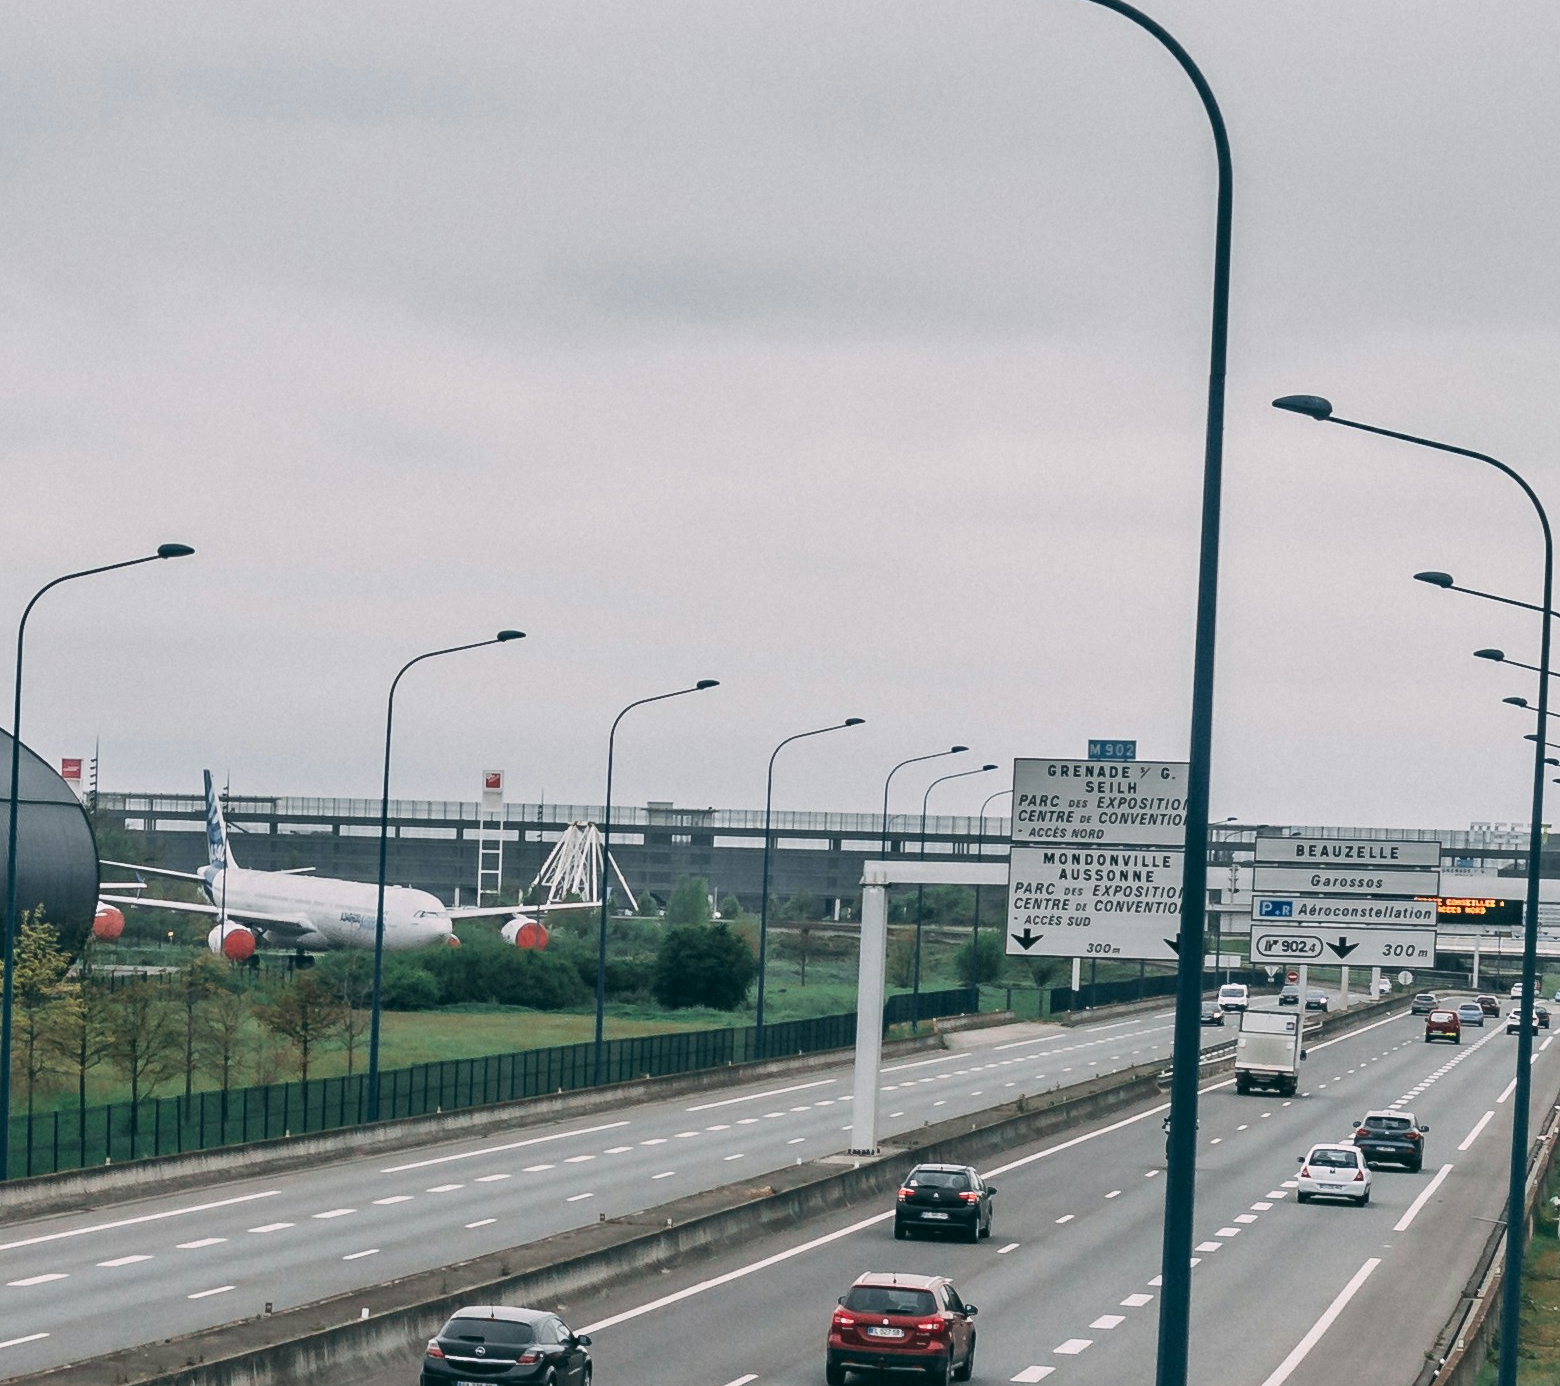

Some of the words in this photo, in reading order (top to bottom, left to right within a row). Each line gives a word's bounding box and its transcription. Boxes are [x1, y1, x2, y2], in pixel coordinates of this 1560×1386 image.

[1090, 744, 1100, 755] M
[1105, 743, 1134, 757] 902
[1048, 764, 1130, 779] GRENADE
[1160, 767, 1176, 780] G.
[1085, 781, 1137, 794] SEILH
[1018, 795, 1060, 807] PARC
[1068, 799, 1088, 809] DES
[1096, 796, 1188, 811] EXPOSITIO
[1018, 810, 1074, 824] CENTRE
[1080, 815, 1092, 824] DE
[1098, 811, 1187, 827] CONVENTIO
[1028, 826, 1067, 838] ACCÈS
[1070, 829, 1105, 839] NORD
[1296, 844, 1399, 859] BEAUZELLE
[1043, 852, 1172, 869] MONDONVILLE
[1058, 868, 1155, 883] AUSSONNE
[1310, 874, 1384, 889] Garossos
[1014, 882, 1056, 895] PARC
[1064, 887, 1084, 896] DES
[1092, 885, 1183, 899] EXPOSITIO
[1014, 897, 1070, 911] CENTRE
[1075, 903, 1088, 912] DE
[1094, 899, 1182, 915] CONVENTIO
[1298, 903, 1432, 919] Aéroconstellation
[1024, 914, 1062, 926] ACCÈS
[1067, 916, 1092, 927] SUD
[1382, 943, 1416, 957] 300
[1418, 949, 1428, 958] m
